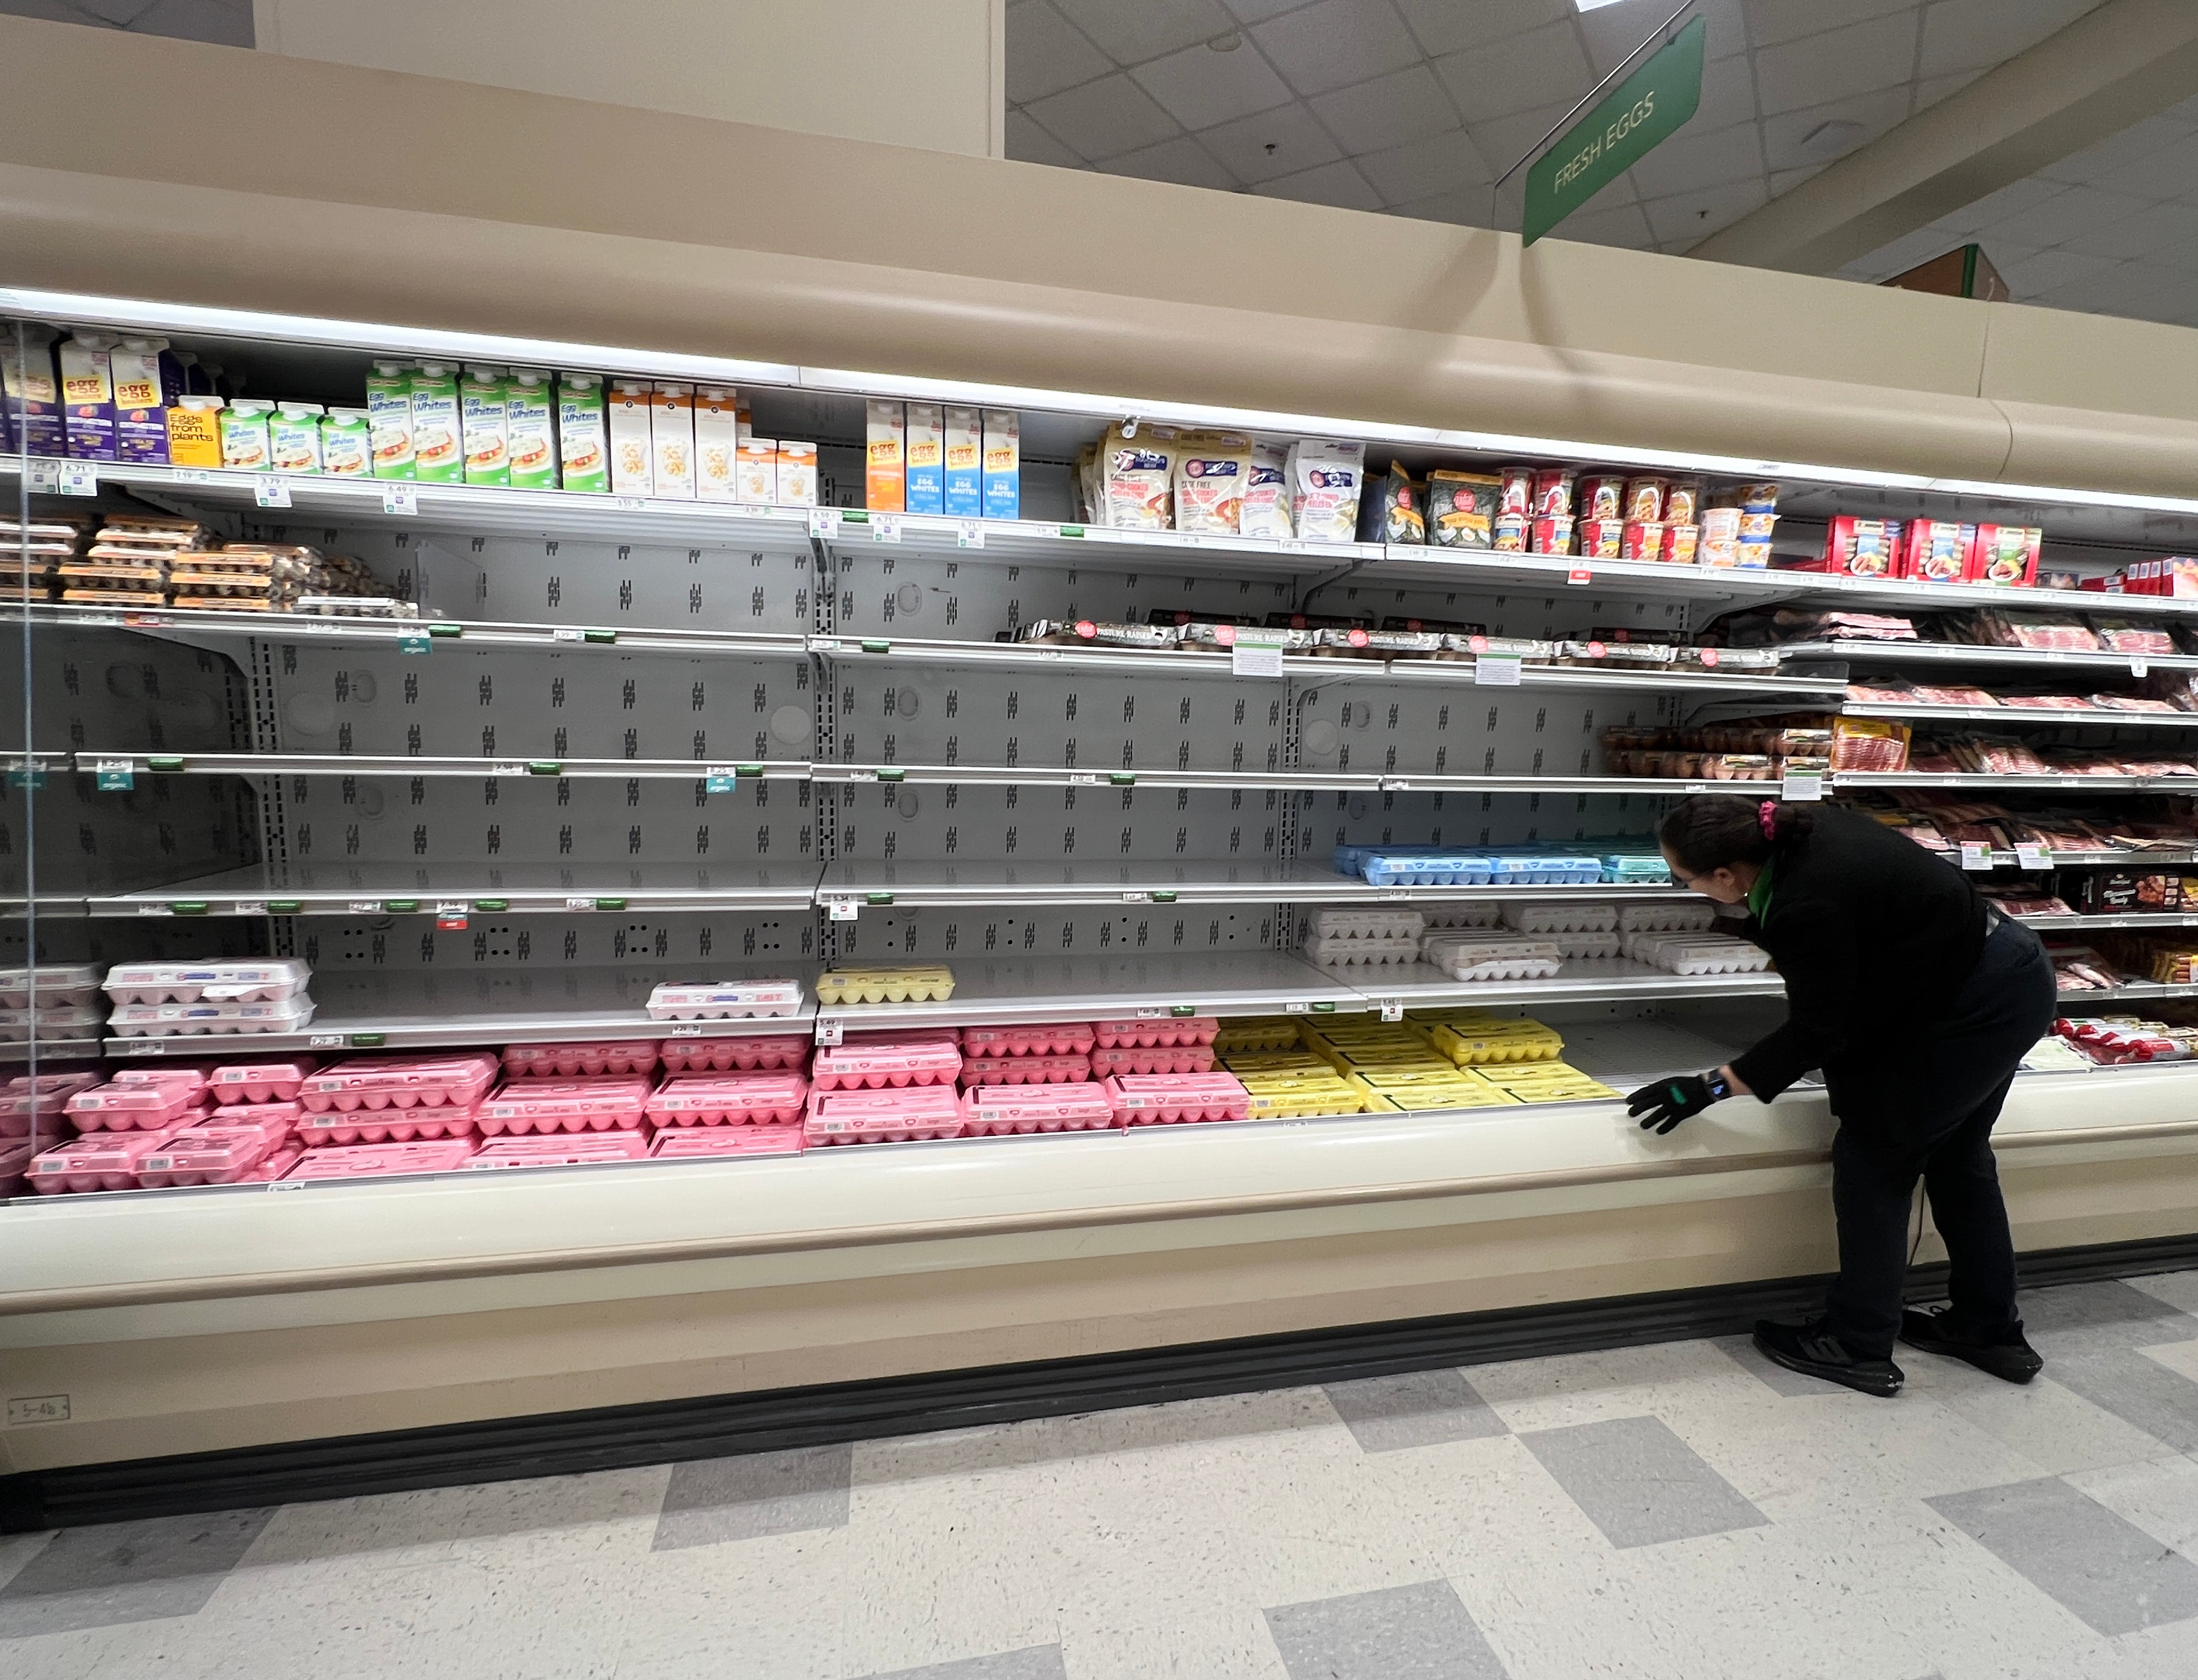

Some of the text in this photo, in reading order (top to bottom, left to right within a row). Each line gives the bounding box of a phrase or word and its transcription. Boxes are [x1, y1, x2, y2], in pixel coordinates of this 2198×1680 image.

[1554, 91, 1654, 193] FRESH EGGS
[66, 379, 99, 393] egg
[118, 385, 151, 397] egg
[413, 393, 429, 401] Egg
[464, 398, 480, 406] Egg
[414, 401, 452, 412] Whites
[508, 401, 524, 409] Egg
[465, 407, 503, 417] Whites
[509, 408, 545, 420] Whites
[563, 412, 598, 423] Whites
[170, 415, 203, 424] Eggs
[172, 433, 213, 442] plants
[870, 444, 895, 456] egg
[910, 445, 935, 457] egg
[949, 448, 972, 460] egg
[987, 452, 1010, 463] egg
[911, 484, 940, 493] WHITES
[949, 487, 977, 495] WHITES
[987, 490, 1015, 498] WHITES
